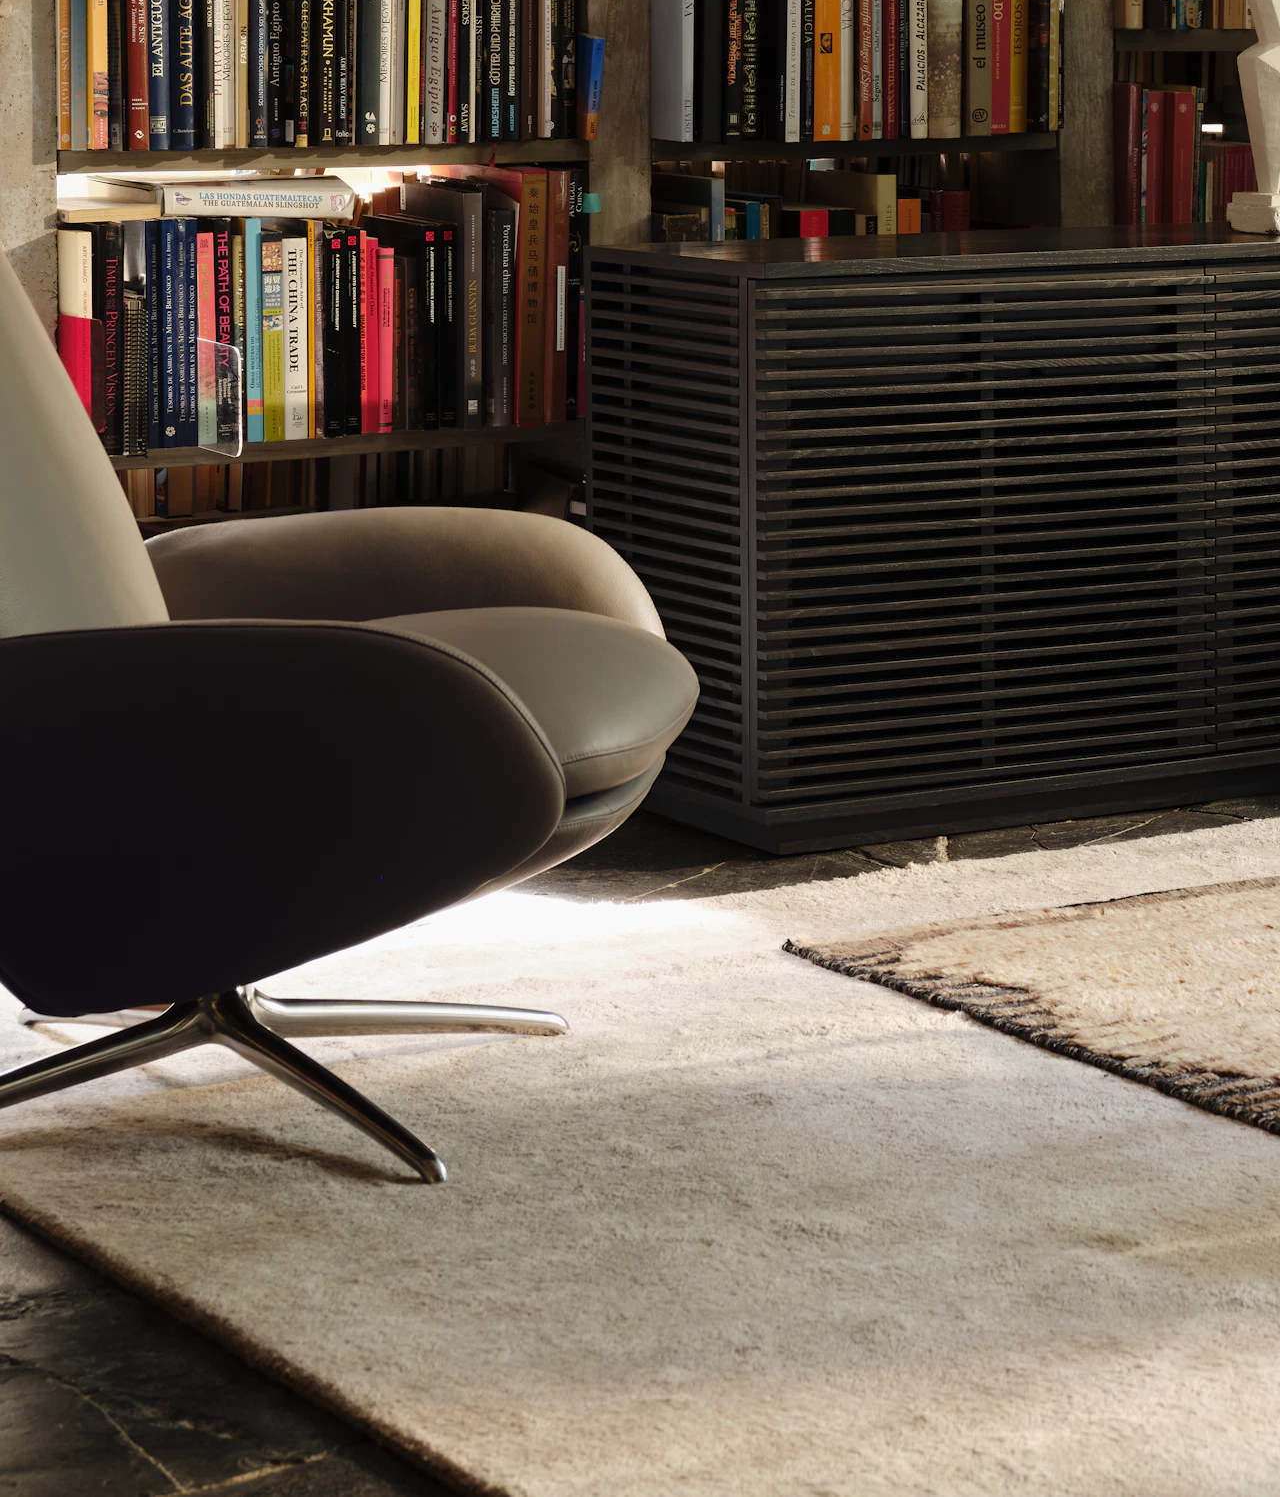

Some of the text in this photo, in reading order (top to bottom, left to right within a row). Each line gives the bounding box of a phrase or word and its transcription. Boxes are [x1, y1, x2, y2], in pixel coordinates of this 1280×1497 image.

[180, 26, 193, 68] ALTE
[430, 4, 442, 63] Antiguo
[976, 5, 985, 51] museo
[152, 65, 163, 78] EL
[915, 49, 926, 91] PALACIOS
[973, 56, 985, 69] el
[180, 72, 193, 106] DAS
[430, 67, 442, 114] Egipto
[460, 103, 468, 133] SALVAT
[501, 223, 512, 293] Porcelana china
[218, 231, 230, 367] THE PATH OF BEAUTY
[289, 247, 298, 372] THE CHINA TRADE
